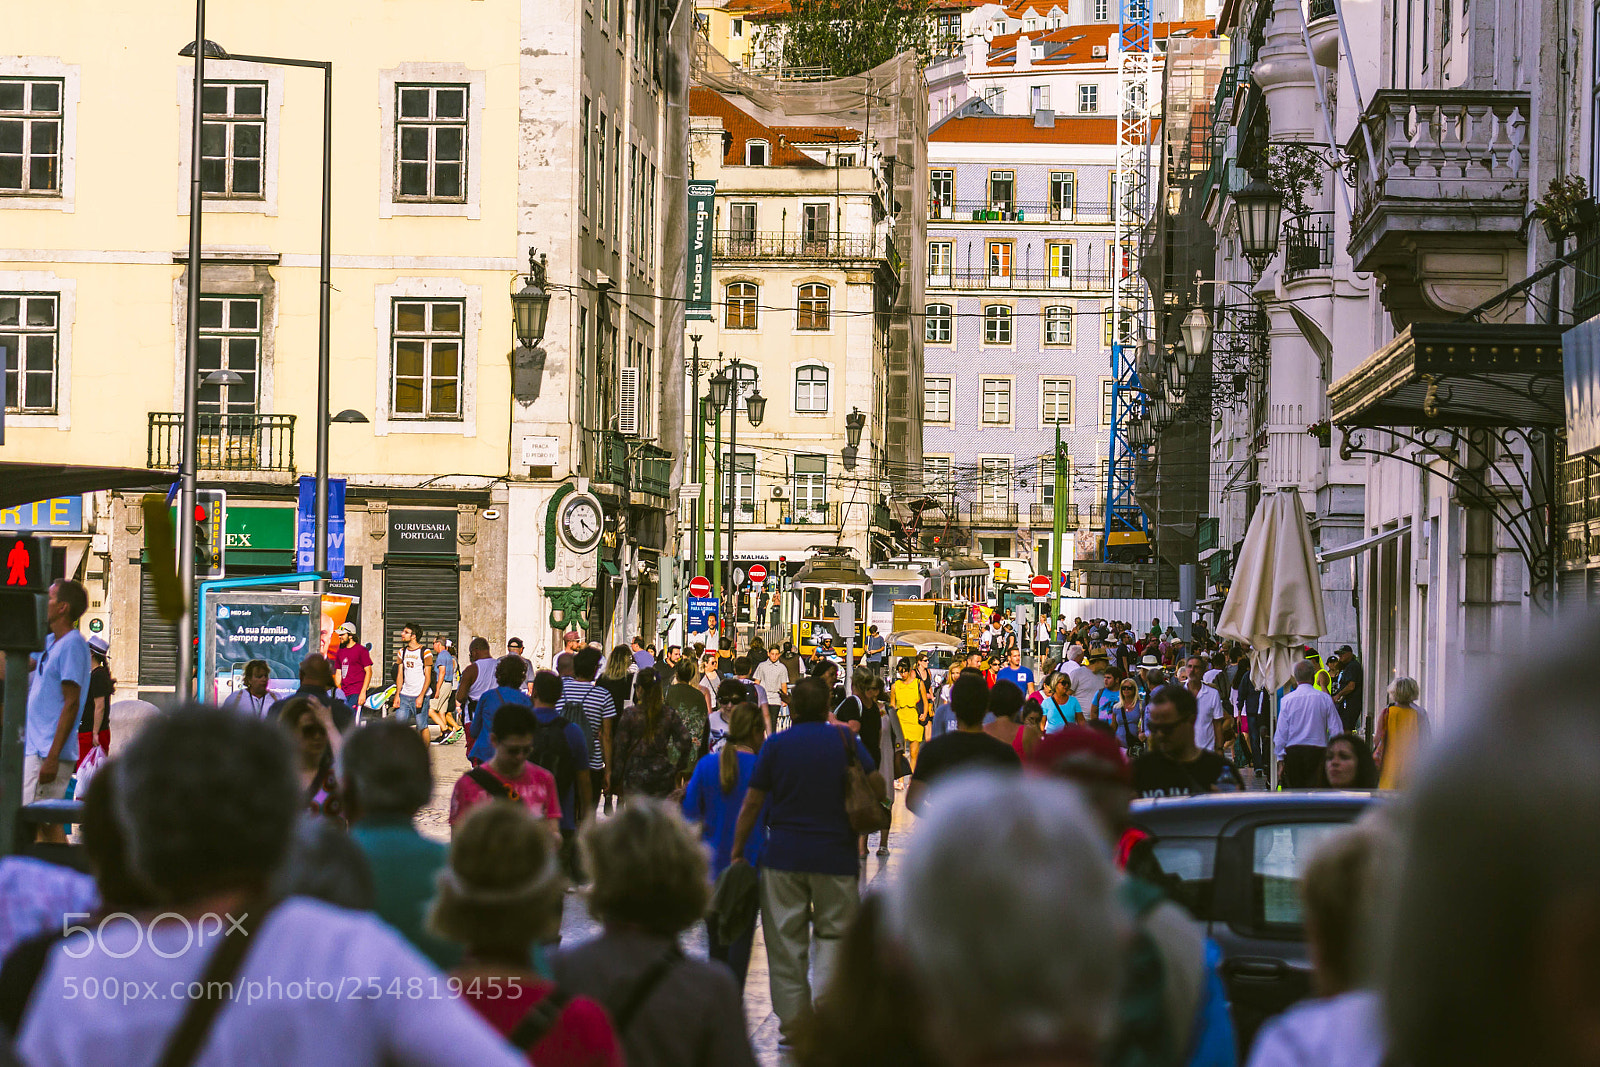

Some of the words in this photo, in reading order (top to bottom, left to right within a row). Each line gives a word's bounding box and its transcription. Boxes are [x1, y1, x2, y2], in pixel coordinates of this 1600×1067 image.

[694, 201, 709, 250] Vouga
[693, 254, 703, 301] Tubos
[394, 523, 451, 531] OURIVESARIA
[212, 500, 220, 569] BOMBEIROS
[400, 532, 445, 540] PORTUGAL
[889, 586, 899, 594] 15
[237, 626, 244, 634] A
[229, 635, 258, 643] sempre
[260, 636, 273, 644] por
[274, 635, 296, 644] perto
